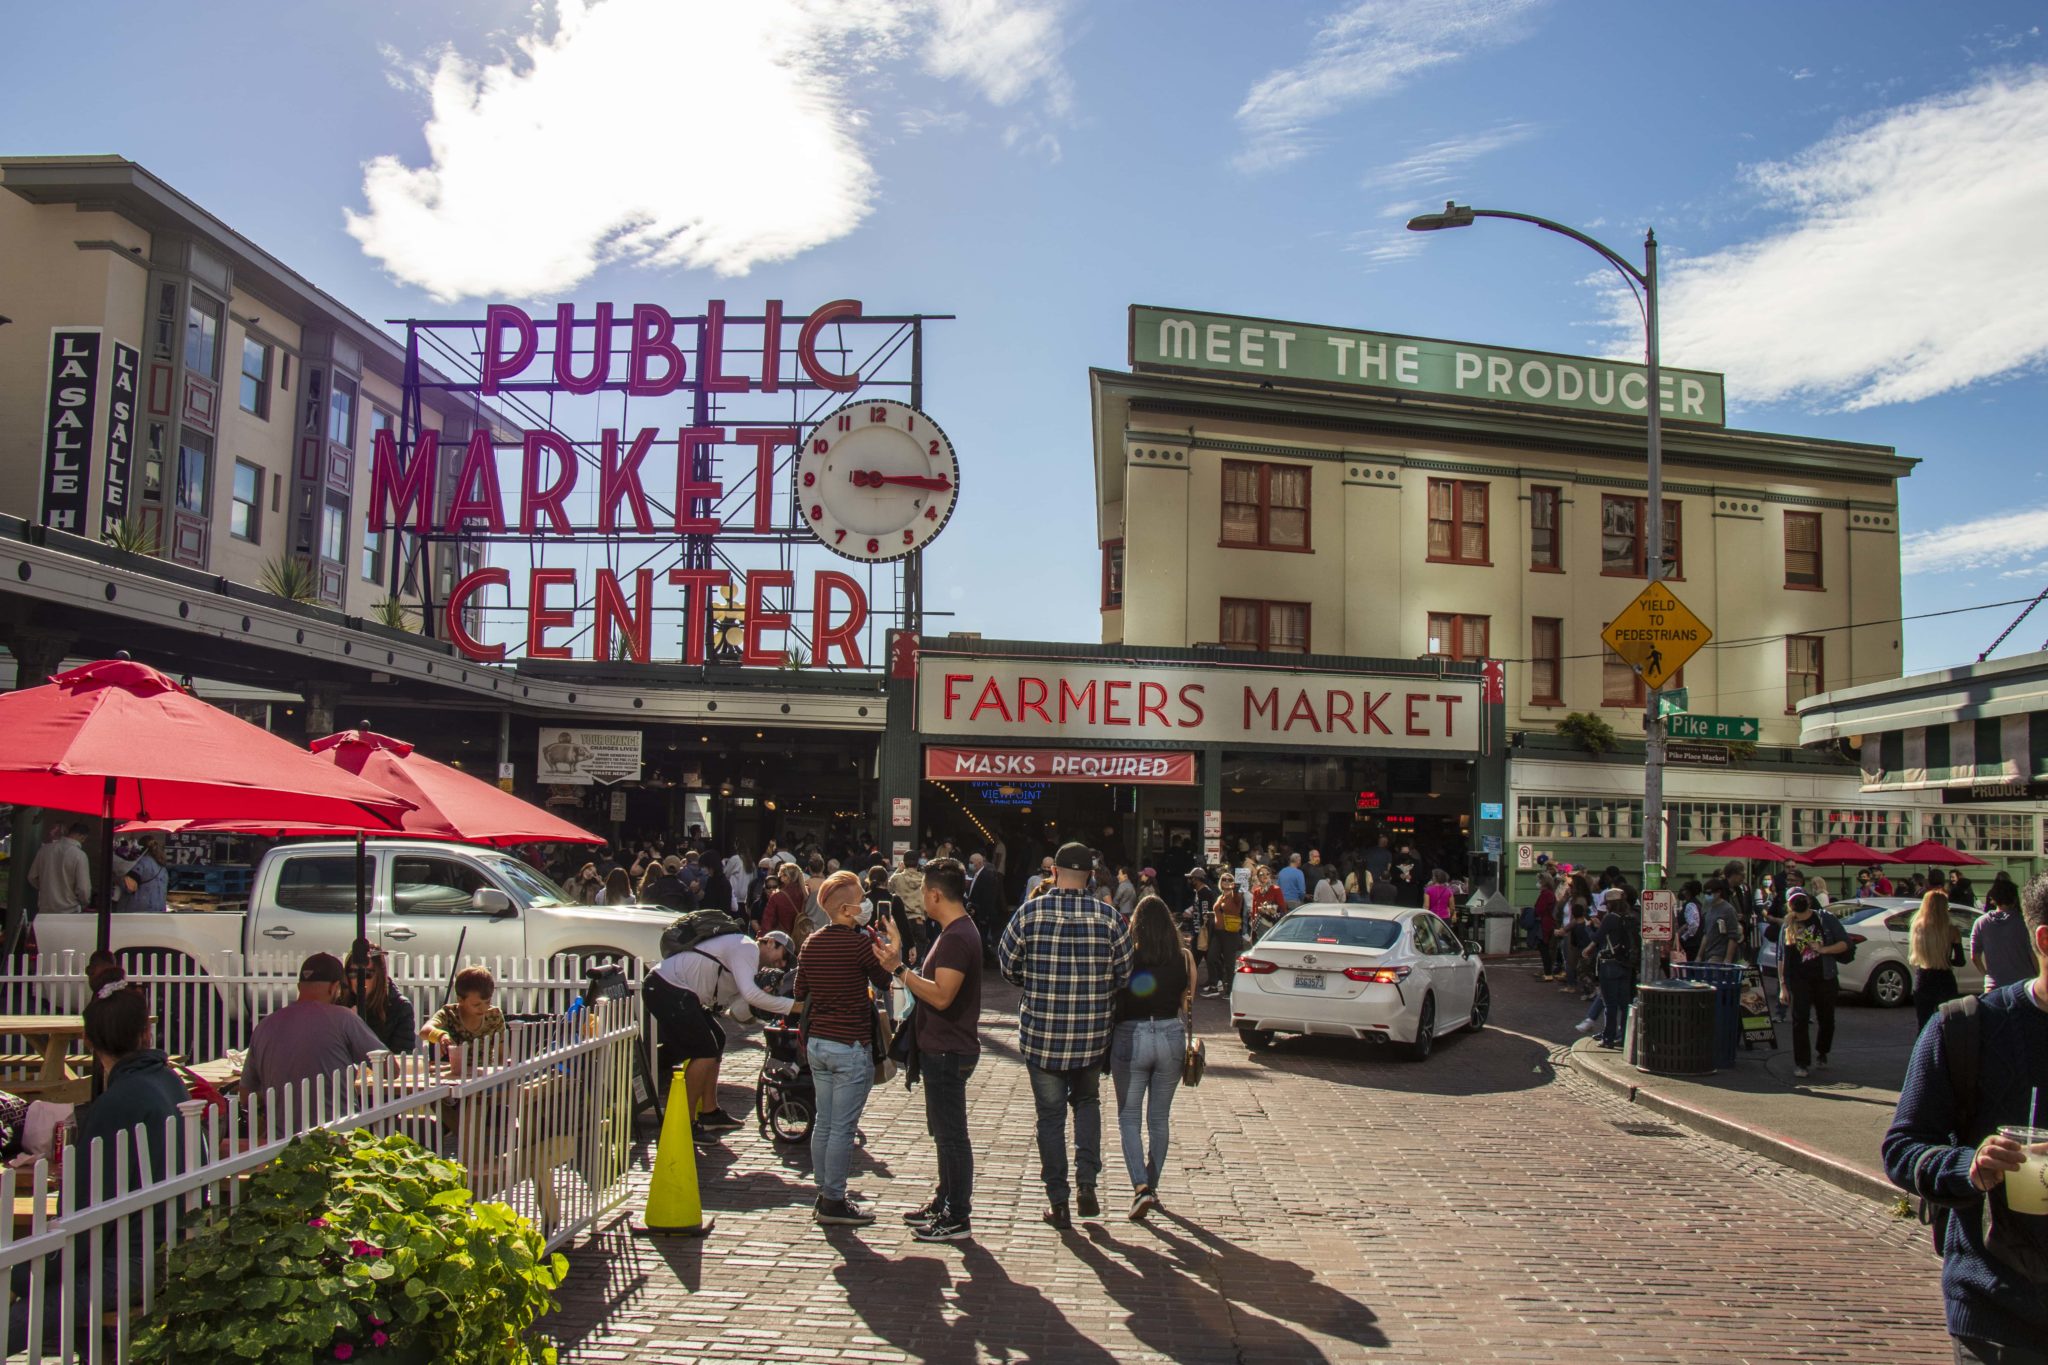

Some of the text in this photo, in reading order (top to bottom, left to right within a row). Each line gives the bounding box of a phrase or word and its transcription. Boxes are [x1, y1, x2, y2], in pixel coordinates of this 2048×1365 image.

[481, 299, 863, 397] PUBLIC
[58, 338, 89, 378] LA
[116, 348, 133, 392] LA
[1159, 318, 1706, 416] MEET THE PRODUCER
[870, 406, 887, 422] 12
[838, 415, 850, 431] 11
[908, 415, 914, 431] 1
[52, 387, 87, 494] SALLE
[813, 439, 828, 454] 10
[929, 440, 940, 455] 2
[107, 401, 129, 506] SALLE
[368, 427, 800, 535] MARKET
[803, 472, 816, 487] 9
[811, 504, 823, 520] 8
[924, 505, 938, 521] 4
[835, 529, 847, 544] 7
[903, 529, 914, 545] 5
[866, 538, 879, 553] 6
[1640, 599, 1675, 611] YIELD
[445, 566, 868, 669] CENTER
[1649, 614, 1664, 626] TO
[1615, 629, 1698, 641] PEDESTRIANS
[944, 673, 1463, 737] FARMERS MARKET
[1672, 716, 1728, 736] Pike Pl
[605, 735, 639, 746] CHANGE
[1668, 751, 1726, 762] Pike Place Market
[955, 754, 1169, 777] MASKS REQUIRED
[1972, 783, 2028, 798] PRODUCE
[1643, 892, 1653, 900] NO
[1645, 902, 1668, 911] STOPS
